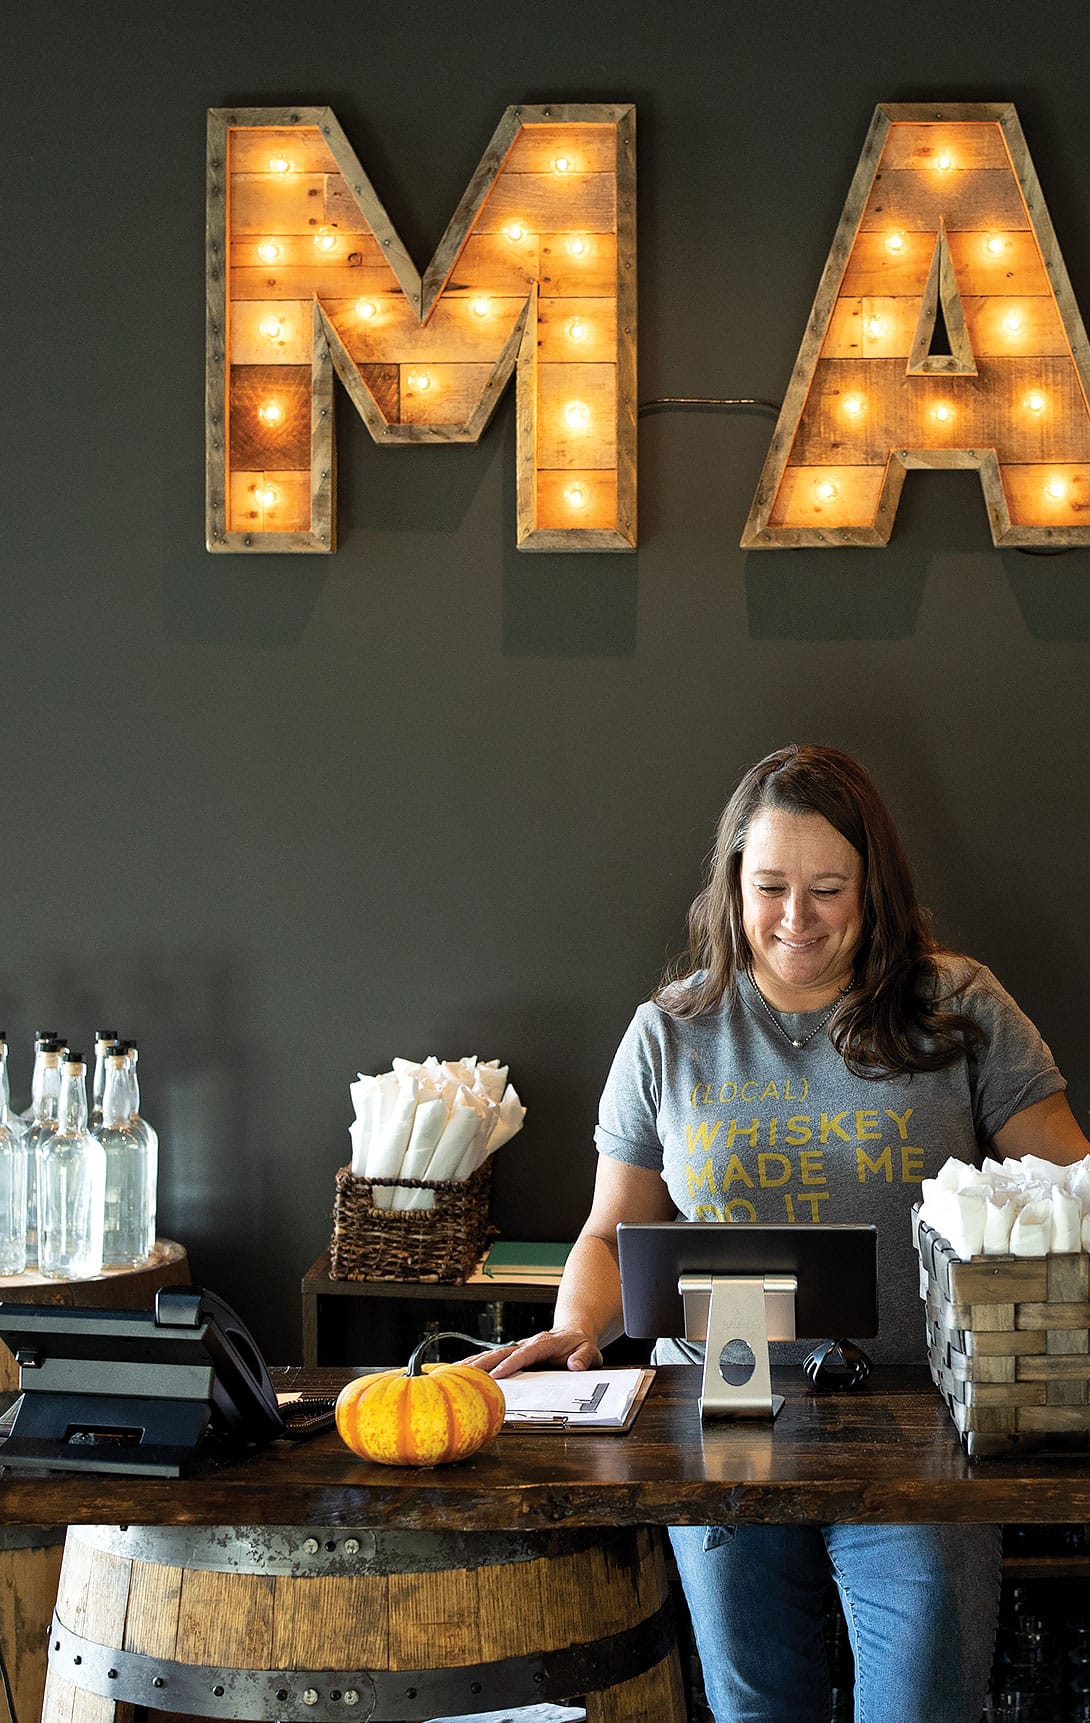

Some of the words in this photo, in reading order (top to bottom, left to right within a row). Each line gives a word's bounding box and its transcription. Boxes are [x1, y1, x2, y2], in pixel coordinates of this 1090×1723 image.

[690, 1077, 809, 1106] (LOCAL)
[685, 1108, 914, 1156] WHISKEY
[684, 1150, 828, 1199] MADE
[856, 1146, 925, 1183] ME
[784, 1192, 830, 1223] IT
